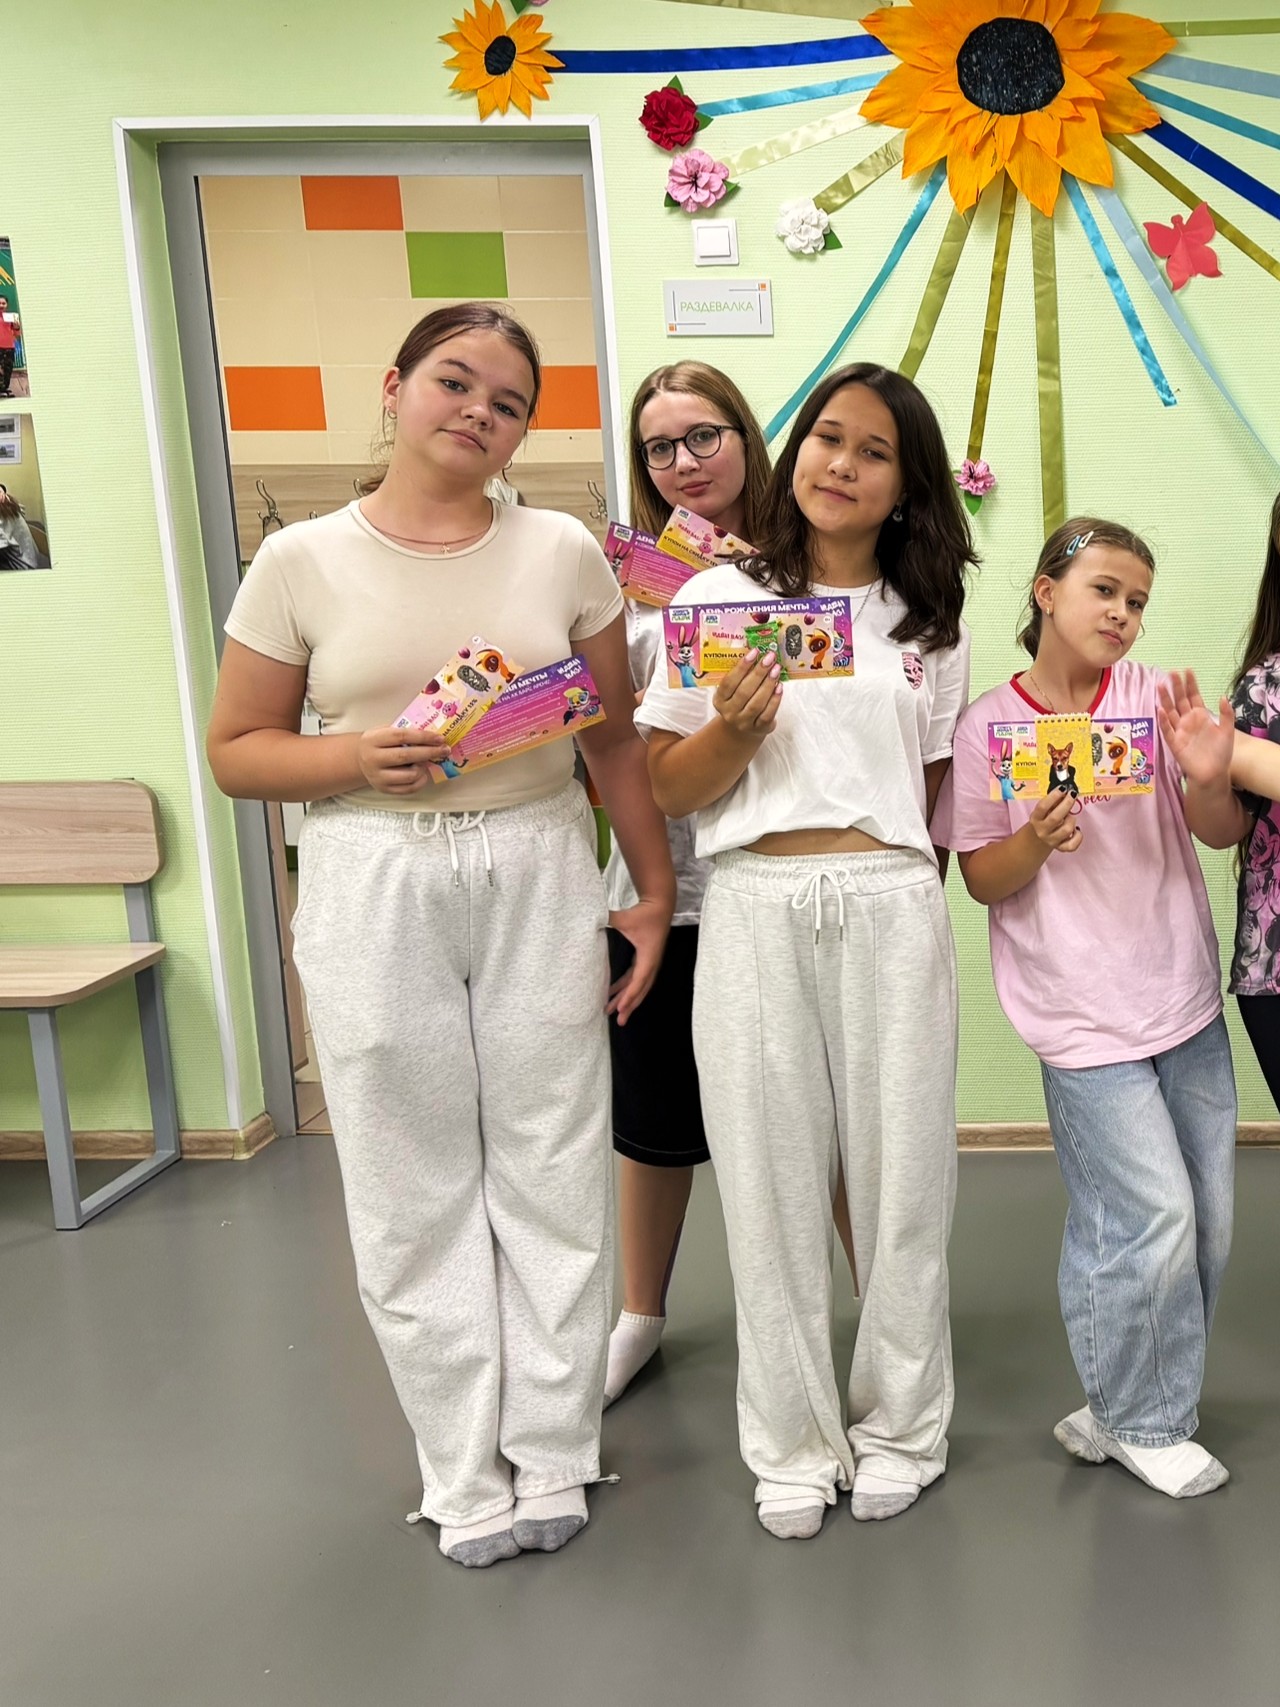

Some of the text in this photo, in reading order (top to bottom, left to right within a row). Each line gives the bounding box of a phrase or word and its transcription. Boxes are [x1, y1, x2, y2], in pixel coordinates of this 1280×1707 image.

[680, 301, 754, 313] РАЗДЕВАЛКА
[724, 604, 777, 614] РОЖДЕНИЯ
[777, 602, 810, 612] МЕЧТЫ
[517, 671, 549, 688] МЕЧТЫ
